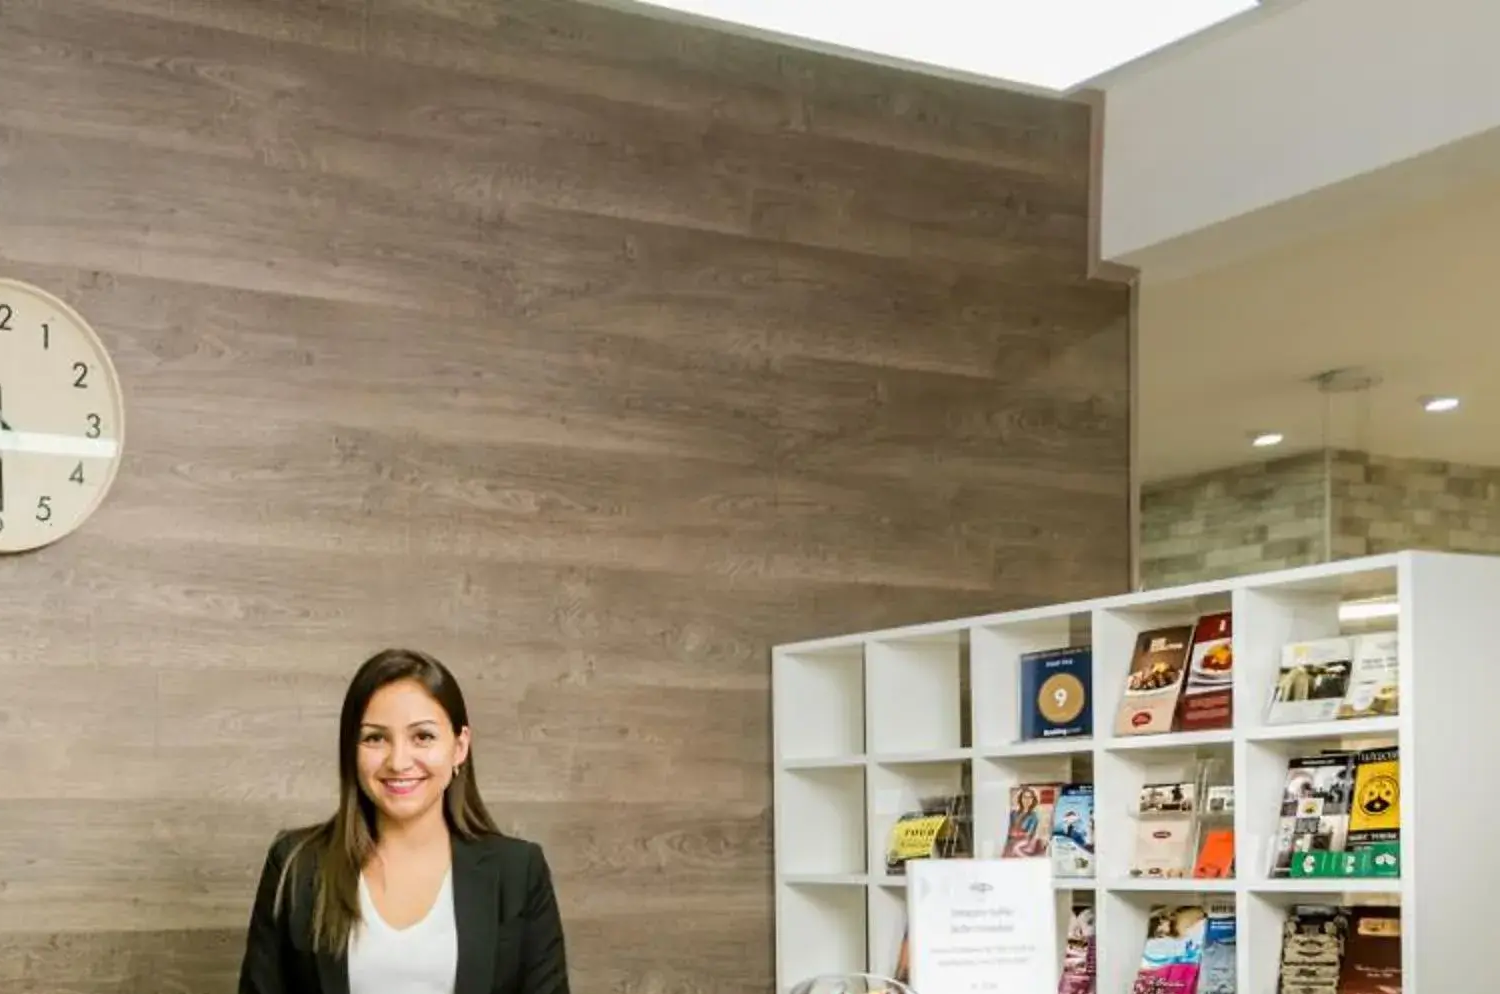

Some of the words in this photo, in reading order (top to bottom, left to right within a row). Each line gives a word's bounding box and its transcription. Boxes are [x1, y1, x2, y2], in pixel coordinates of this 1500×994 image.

[40, 323, 49, 350] 1
[72, 361, 89, 388] 2
[84, 412, 102, 439] 3
[68, 461, 85, 485] 4
[35, 496, 52, 522] 5
